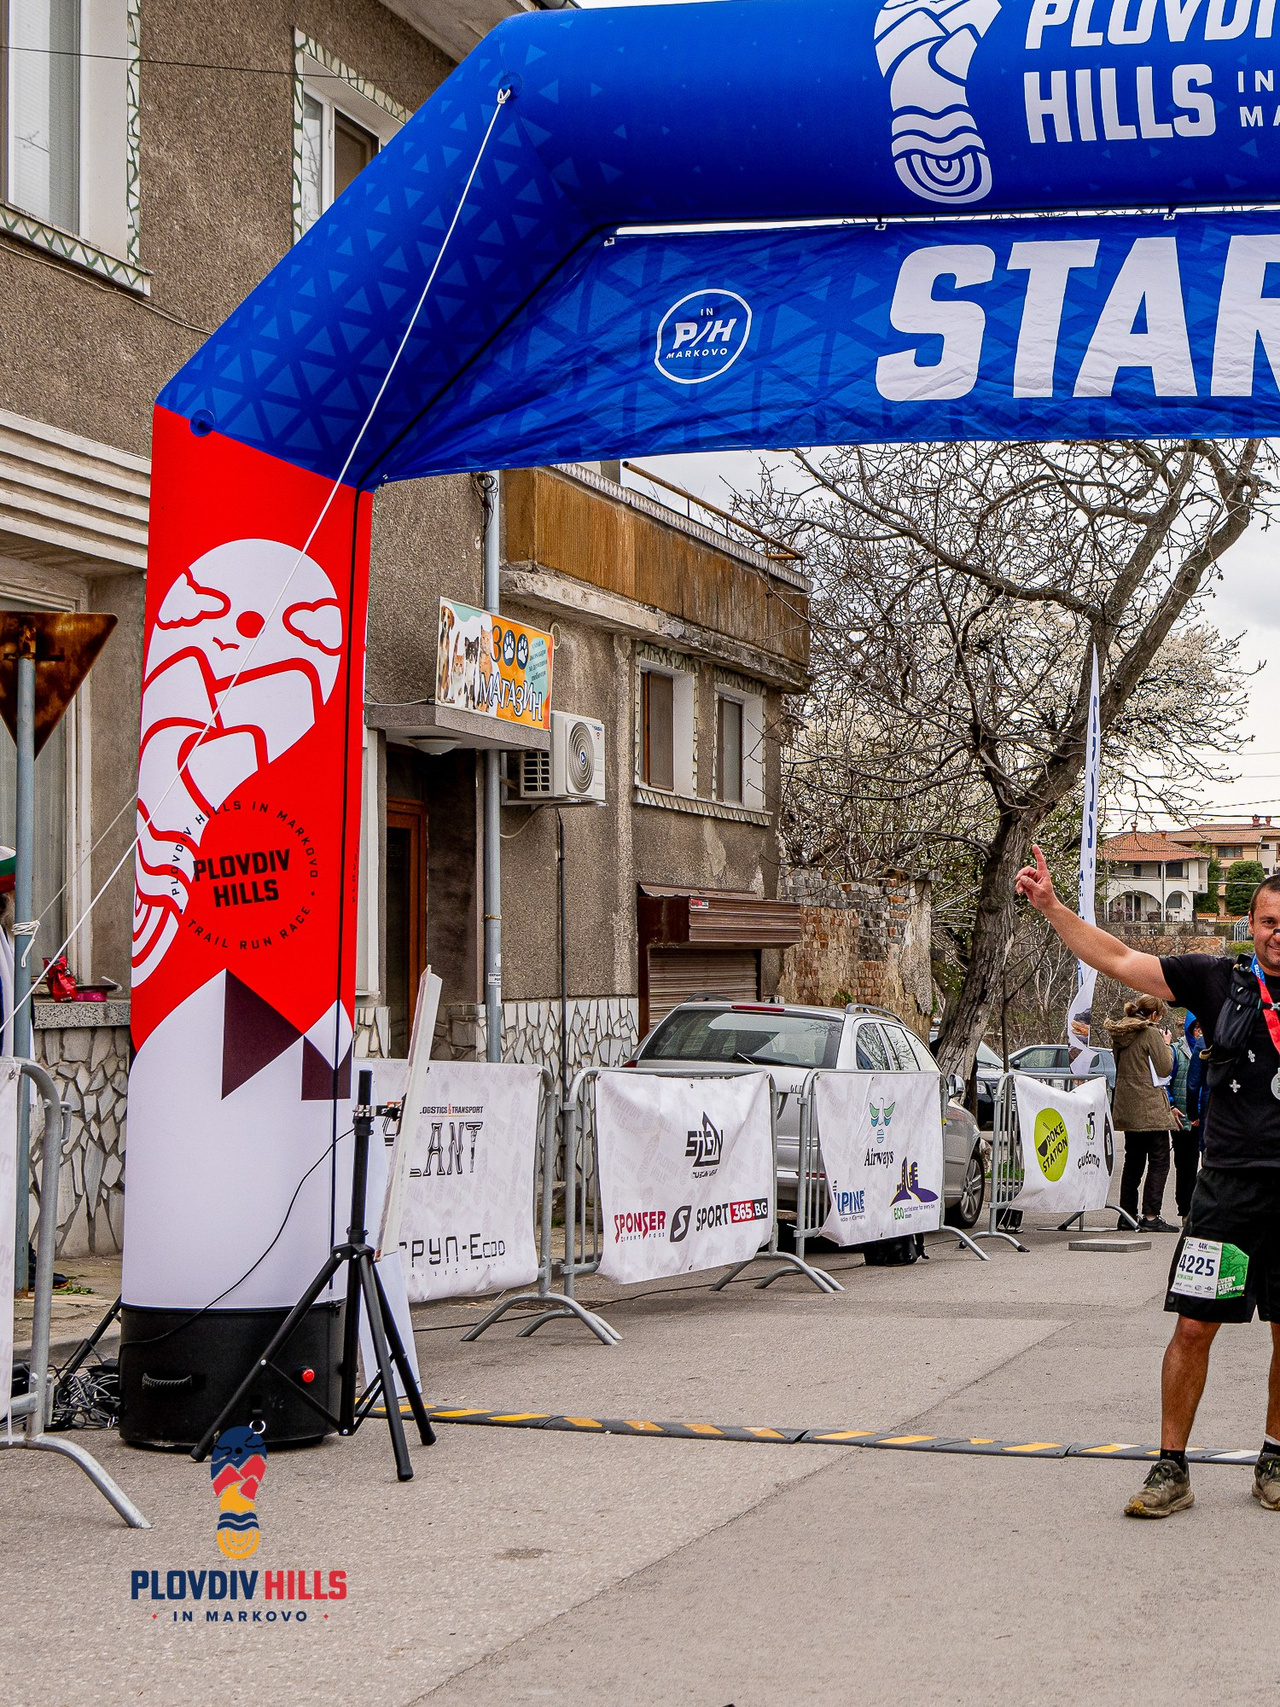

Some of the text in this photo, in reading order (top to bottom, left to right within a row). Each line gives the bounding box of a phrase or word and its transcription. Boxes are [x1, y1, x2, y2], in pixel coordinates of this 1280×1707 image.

[1237, 70, 1274, 93] IN
[1023, 63, 1216, 143] HILLS
[700, 307, 714, 316] IN
[672, 318, 738, 350] P/H
[666, 347, 728, 359] MARKOVO
[477, 672, 544, 722] МАГАЗИН
[251, 801, 269, 813] IN
[193, 848, 290, 882] PLOVDIV
[213, 879, 280, 908] HILLS
[187, 906, 311, 950] TRAIL RUN RACE
[452, 1105, 483, 1114] TRANSPORT
[1046, 1121, 1066, 1147] POKE
[864, 1147, 894, 1168] Airways
[1042, 1137, 1068, 1174] STATION
[613, 1210, 667, 1244] SPONSER
[1178, 1253, 1216, 1277] 4225
